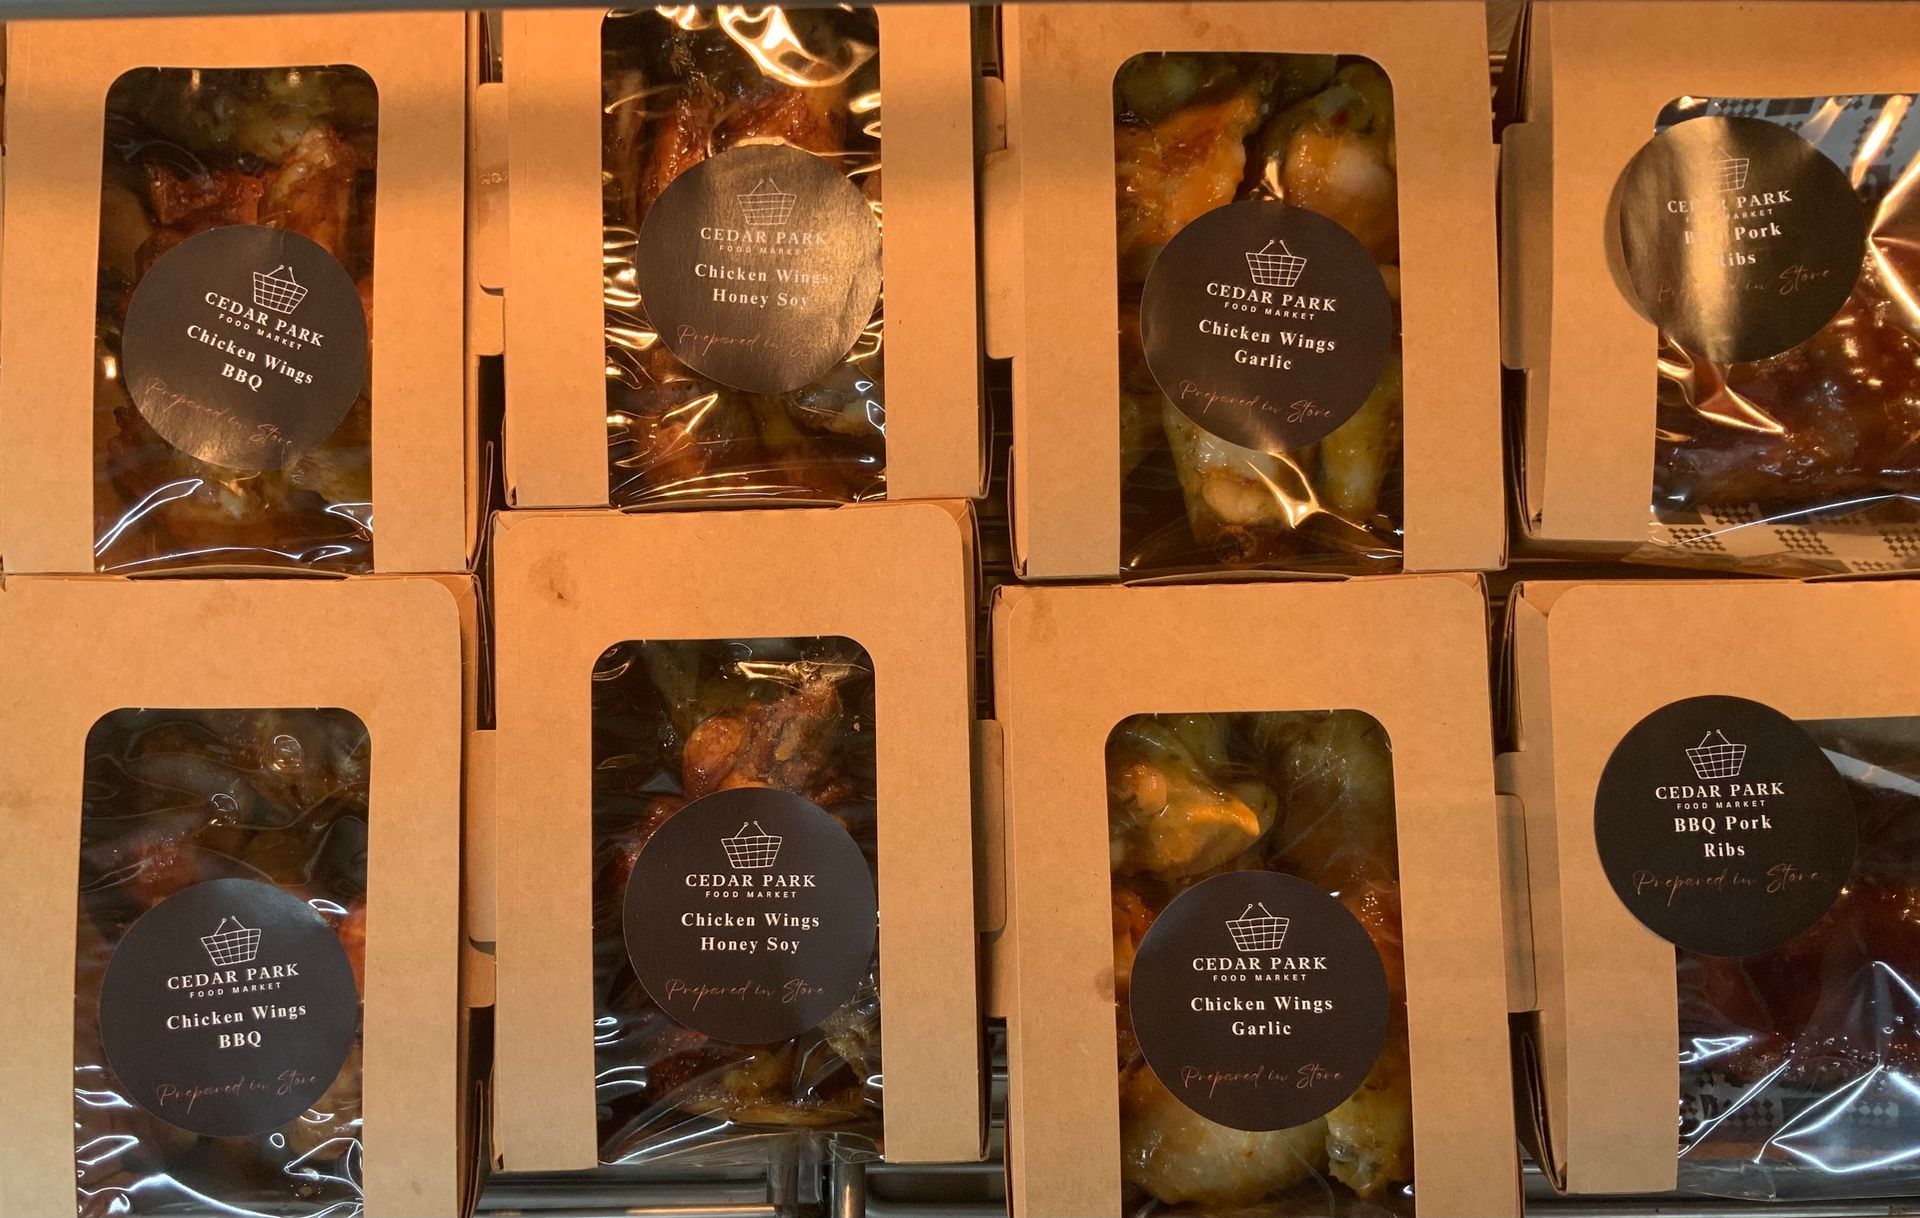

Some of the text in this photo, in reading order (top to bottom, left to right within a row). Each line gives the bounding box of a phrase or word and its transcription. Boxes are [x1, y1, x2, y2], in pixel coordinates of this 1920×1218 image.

[1667, 189, 1792, 213] CER PARK
[700, 227, 827, 245] CEDAR PARK
[1734, 222, 1782, 241] Pork
[719, 244, 810, 256] FOOD MARKET
[694, 263, 829, 285] Chicken Wings
[1778, 264, 1832, 296] Store
[712, 288, 808, 309] Honey Soy
[1206, 282, 1336, 312] CEDAR PARK
[204, 291, 324, 347] CEDAR PARK
[1224, 302, 1316, 320] FOOD MARKET
[218, 313, 302, 350] FOOD MARKET
[677, 324, 759, 357] Prepared
[1198, 319, 1335, 353] Chicken Wings
[186, 324, 314, 385] Chicken Wings
[1234, 349, 1292, 370] Garlic
[220, 363, 263, 392] BBQ
[1179, 379, 1259, 414] Prepared
[1287, 400, 1333, 423] Store
[250, 423, 293, 447] Store
[1655, 782, 1785, 799] CEDAR PARK
[1676, 799, 1766, 810] FOOD MARKET
[1674, 814, 1772, 834] BBQ Pork
[1703, 843, 1745, 857] Ribs
[685, 874, 817, 888] CEDAR PARK
[1633, 863, 1820, 907] Prepared in Store
[681, 912, 820, 931] Chicken Wings
[700, 936, 800, 954] Honey Soy
[1192, 957, 1328, 971] CEDAR PARK
[167, 963, 300, 990] CEDAR PARK
[1213, 973, 1307, 982] FOOD MARKET
[189, 981, 282, 999] FOOD MARKET
[666, 978, 824, 1012] Prepared in Store
[1190, 996, 1333, 1013] Chicken Wings
[166, 1004, 307, 1030] Chicken Wings
[1231, 1021, 1292, 1035] Garlic
[219, 1031, 262, 1049] BBQ
[1182, 1063, 1342, 1099] Prepared in Store
[156, 1069, 316, 1115] Prepared in Store
